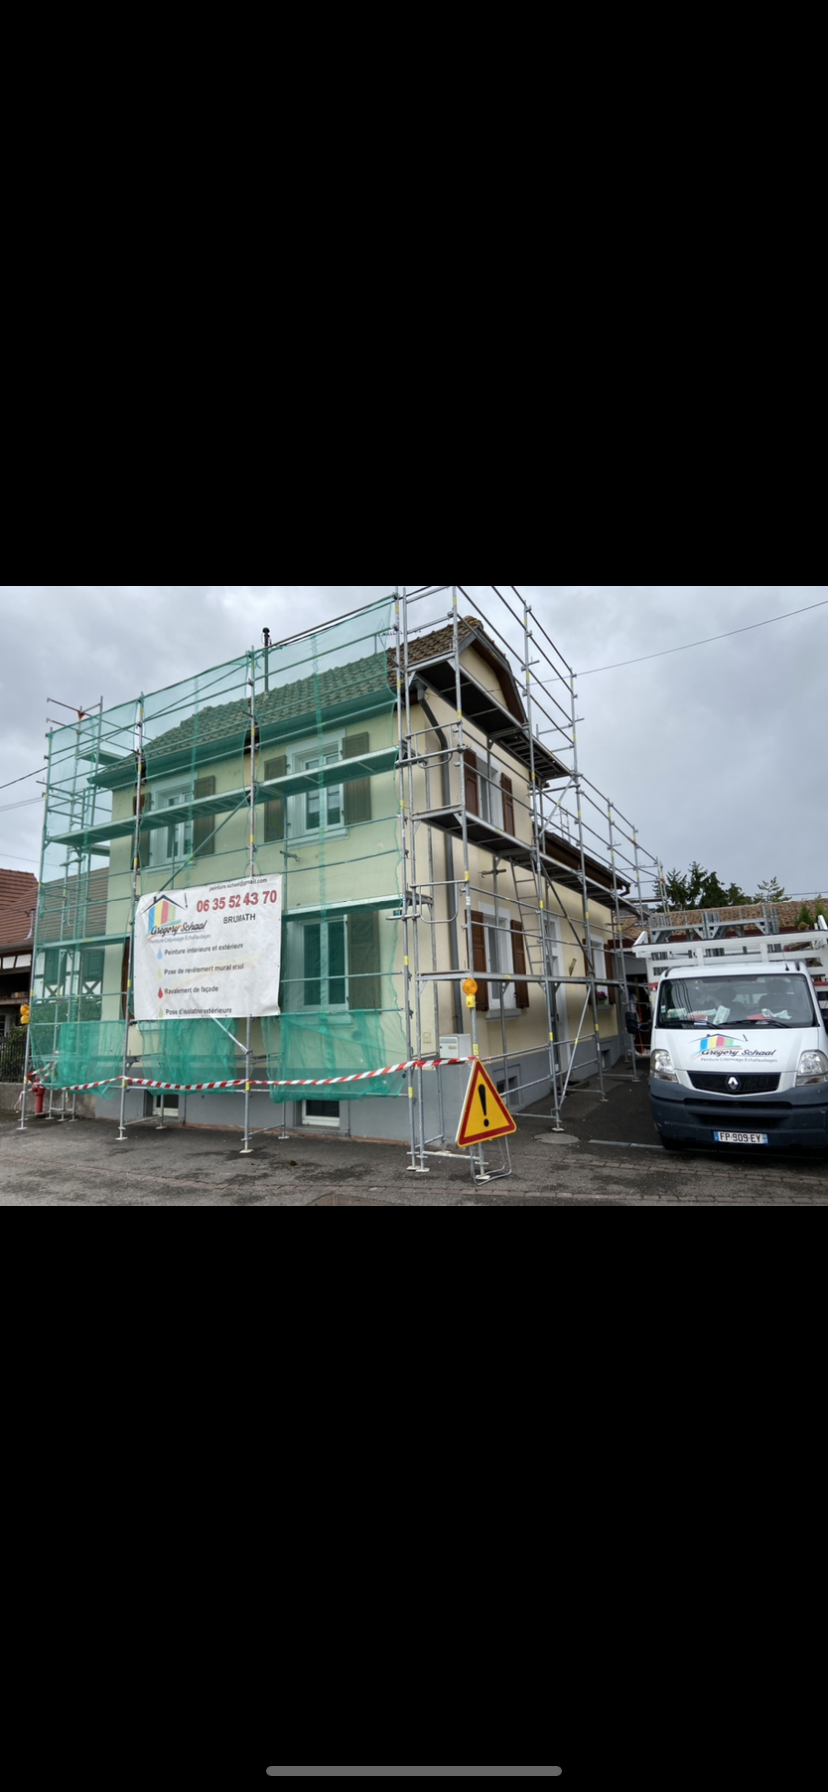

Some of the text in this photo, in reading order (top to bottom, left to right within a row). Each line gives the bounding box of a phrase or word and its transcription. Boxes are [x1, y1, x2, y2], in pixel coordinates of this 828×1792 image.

[196, 890, 277, 913] 06 35 52 43 70
[223, 913, 256, 924] BRUMATH
[180, 919, 208, 932] Schaal
[201, 985, 219, 993] façade
[741, 1048, 777, 1056] Schaal
